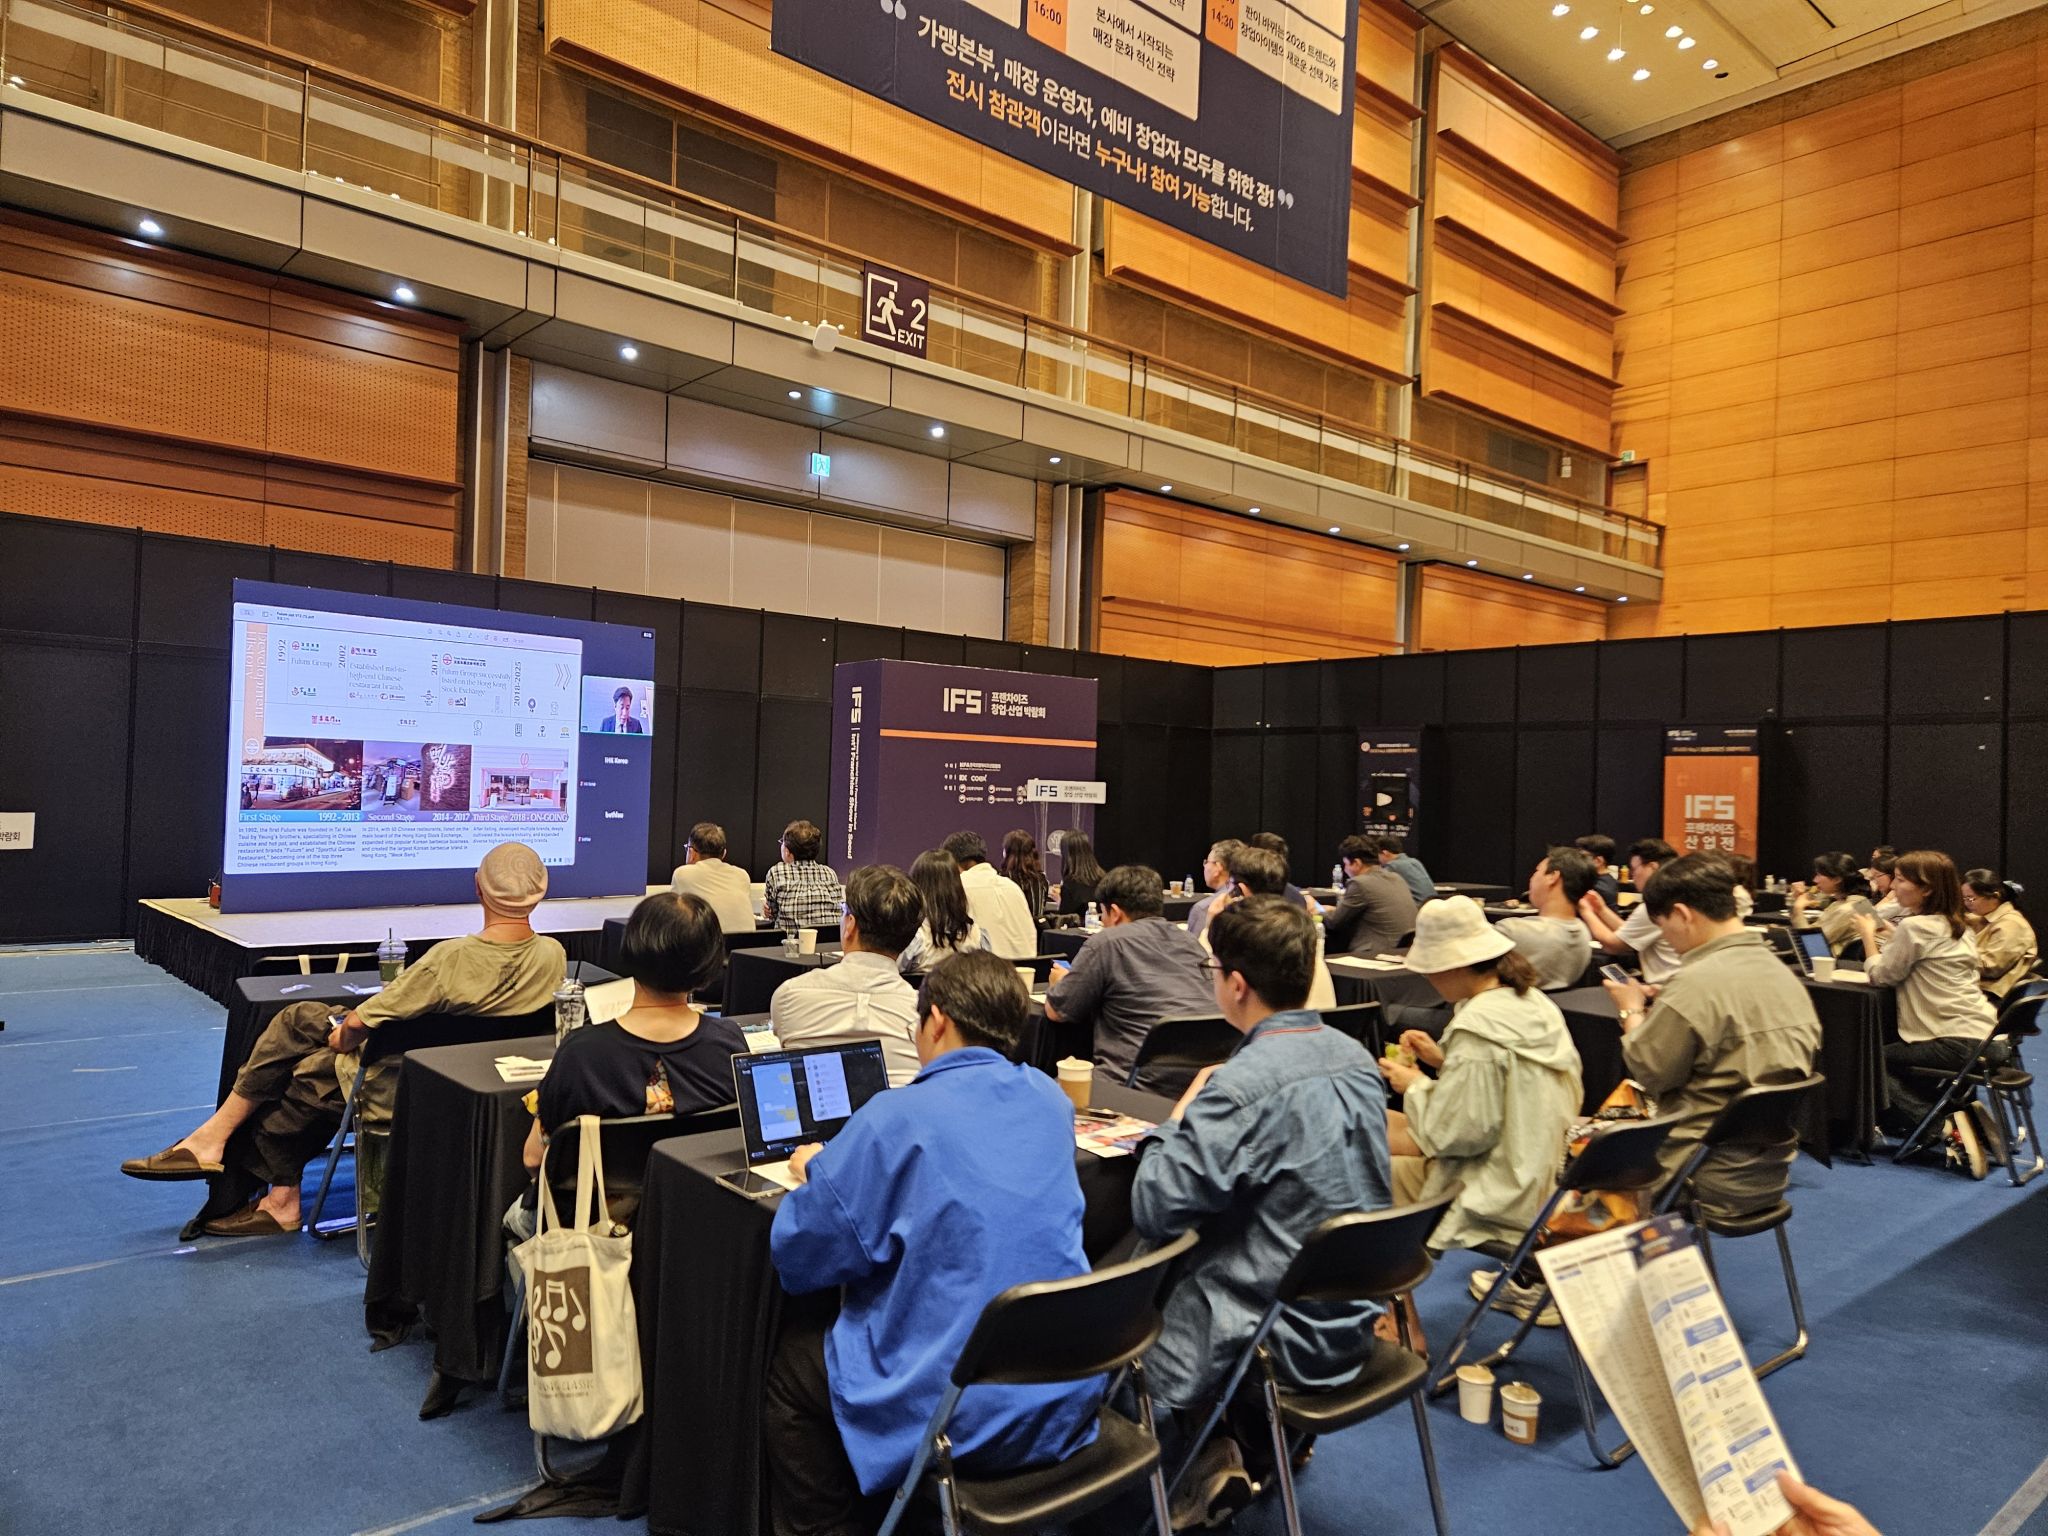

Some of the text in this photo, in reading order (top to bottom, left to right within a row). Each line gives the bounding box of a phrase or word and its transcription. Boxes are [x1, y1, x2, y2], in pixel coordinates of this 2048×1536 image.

[1034, 1, 1062, 25] 16:00
[1212, 9, 1234, 30] 14:30
[1096, 6, 1174, 60] 본사에서 시작되는
[1286, 32, 1305, 52] 2026
[1093, 27, 1175, 82] 매장 문화 혁신 전략
[918, 15, 1000, 82] 가맹본부,
[1004, 58, 1039, 96] 매장
[1042, 78, 1097, 129] 운영자,
[1101, 106, 1132, 142] 예비
[1136, 123, 1181, 165] 창업자
[1183, 147, 1225, 186] 모두를
[1228, 168, 1254, 200] 위한
[947, 69, 1254, 232] 전시 참관객이라면 누구나! 참여 가능합니다.
[910, 299, 926, 331] 2
[898, 329, 924, 349] EXIT
[254, 632, 267, 720] Development
[851, 686, 862, 723] IFS
[943, 688, 981, 714] IFS
[991, 692, 1028, 705] 프랜차이즈
[1024, 706, 1046, 718] 박람회
[1036, 785, 1057, 797] IFS
[260, 813, 281, 822] Stage
[396, 813, 415, 822] Stage
[1685, 795, 1735, 820] IFS
